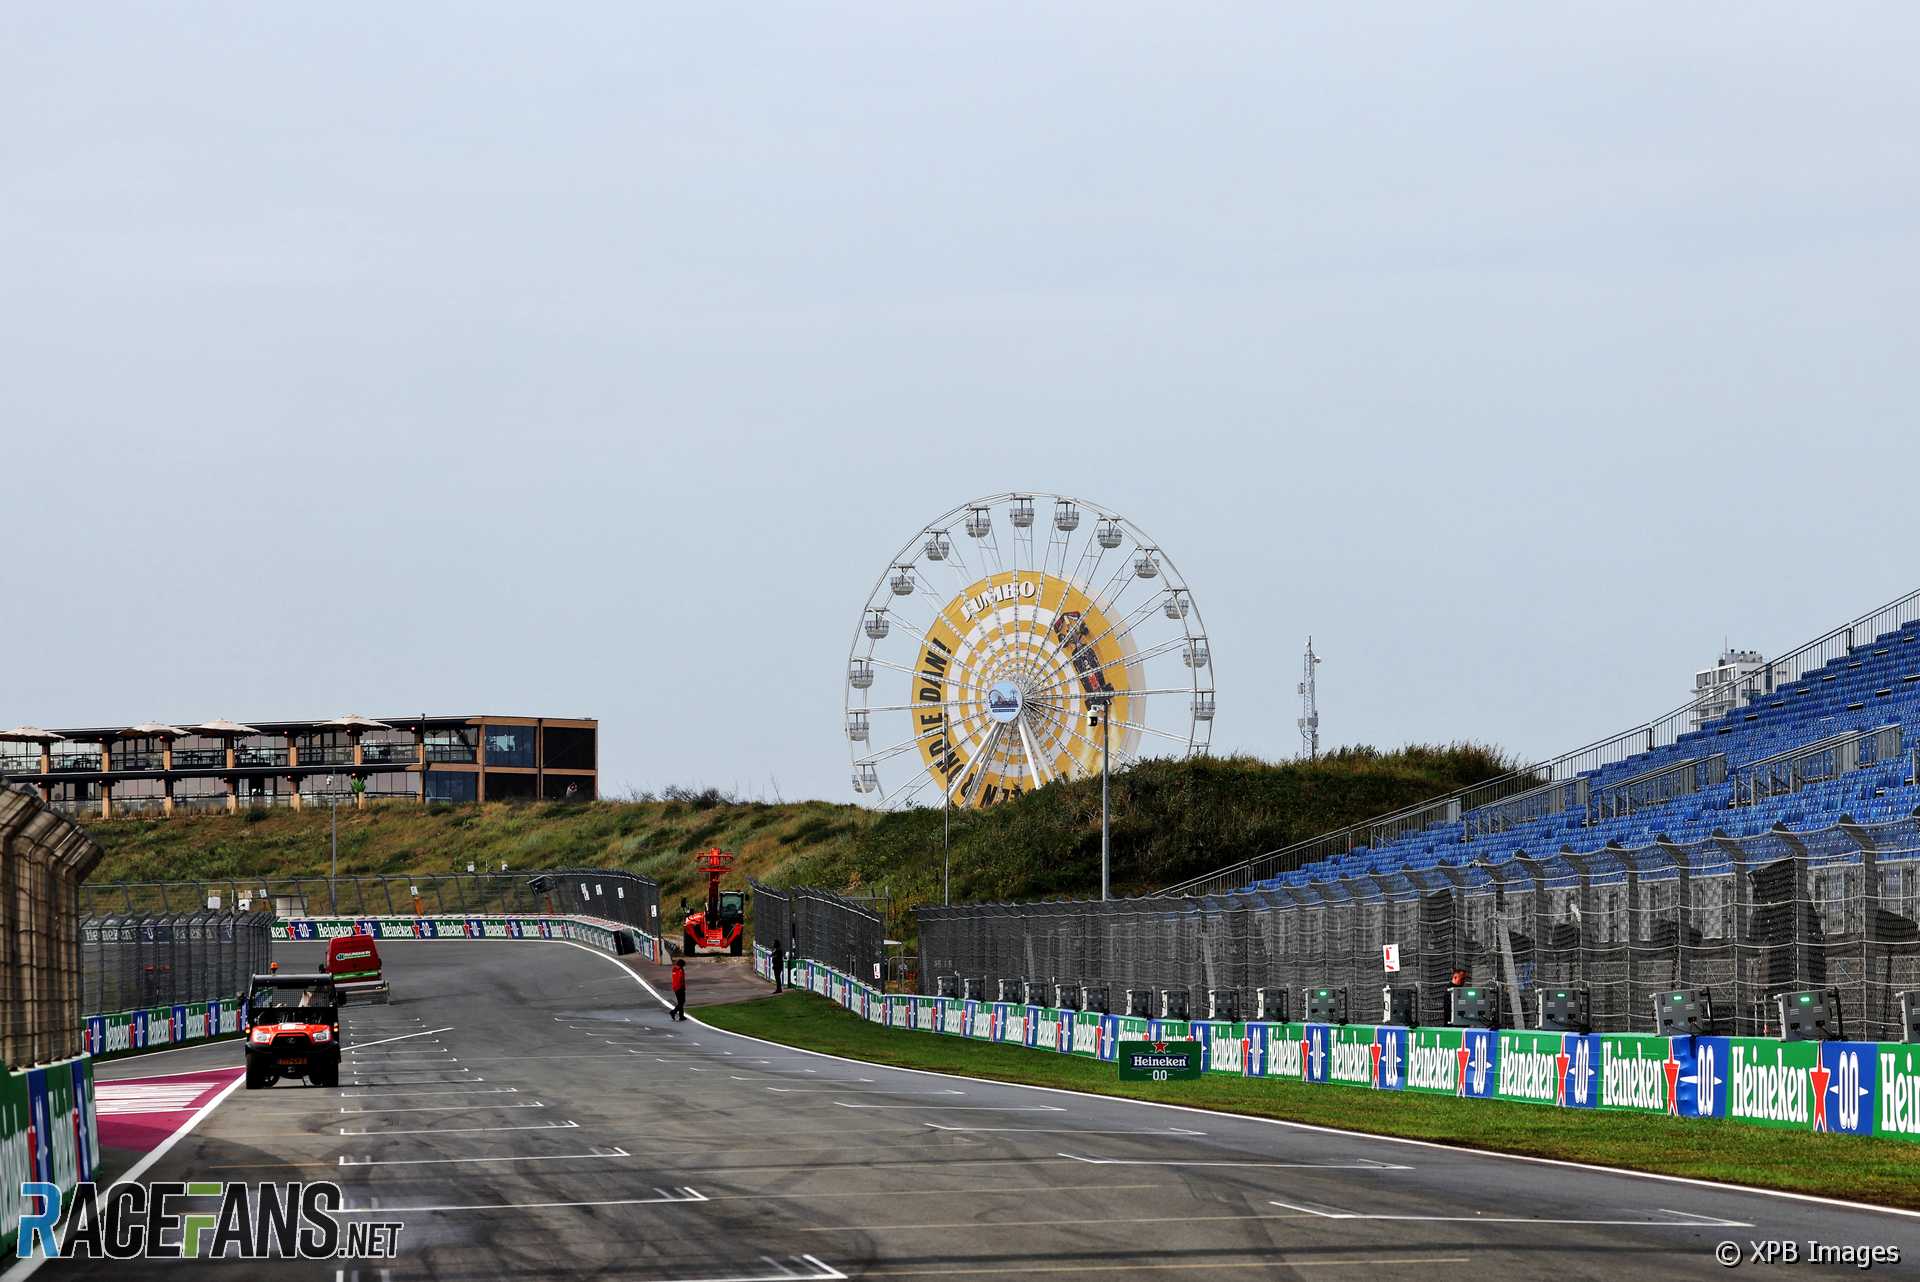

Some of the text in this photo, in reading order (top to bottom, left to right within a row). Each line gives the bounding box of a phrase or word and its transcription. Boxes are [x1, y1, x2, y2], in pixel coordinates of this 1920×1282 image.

[961, 581, 1036, 622] JUMBO
[920, 637, 952, 702] DAN!
[1134, 1056, 1186, 1067] Heineken
[1267, 1027, 1301, 1076] Heineken
[1330, 1029, 1370, 1083] Heineken
[1408, 1032, 1455, 1090] Heineken
[1499, 1036, 1555, 1100] Heineken
[1602, 1041, 1664, 1110] Heineken
[1731, 1045, 1809, 1124] Heineken
